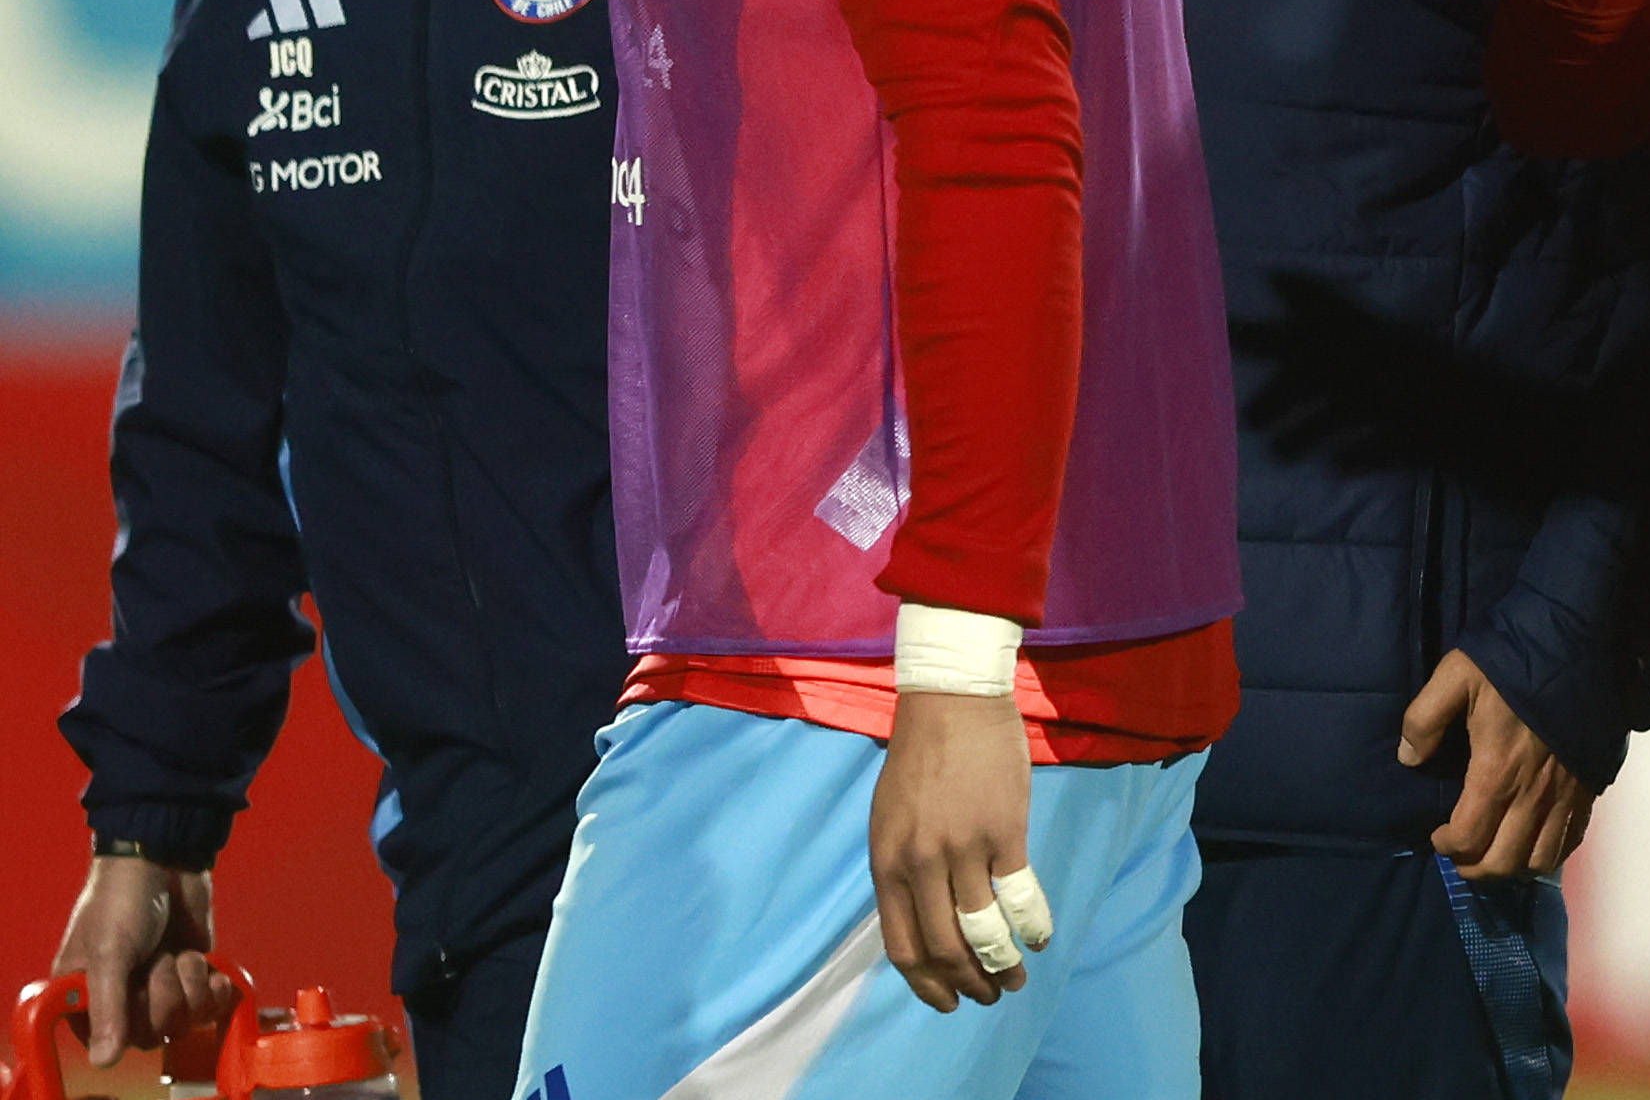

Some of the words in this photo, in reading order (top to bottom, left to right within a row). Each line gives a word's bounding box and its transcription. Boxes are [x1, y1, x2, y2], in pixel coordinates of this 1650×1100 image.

[291, 83, 341, 132] Bci
[483, 76, 588, 108] CRISTAL
[271, 150, 383, 192] MOTOR
